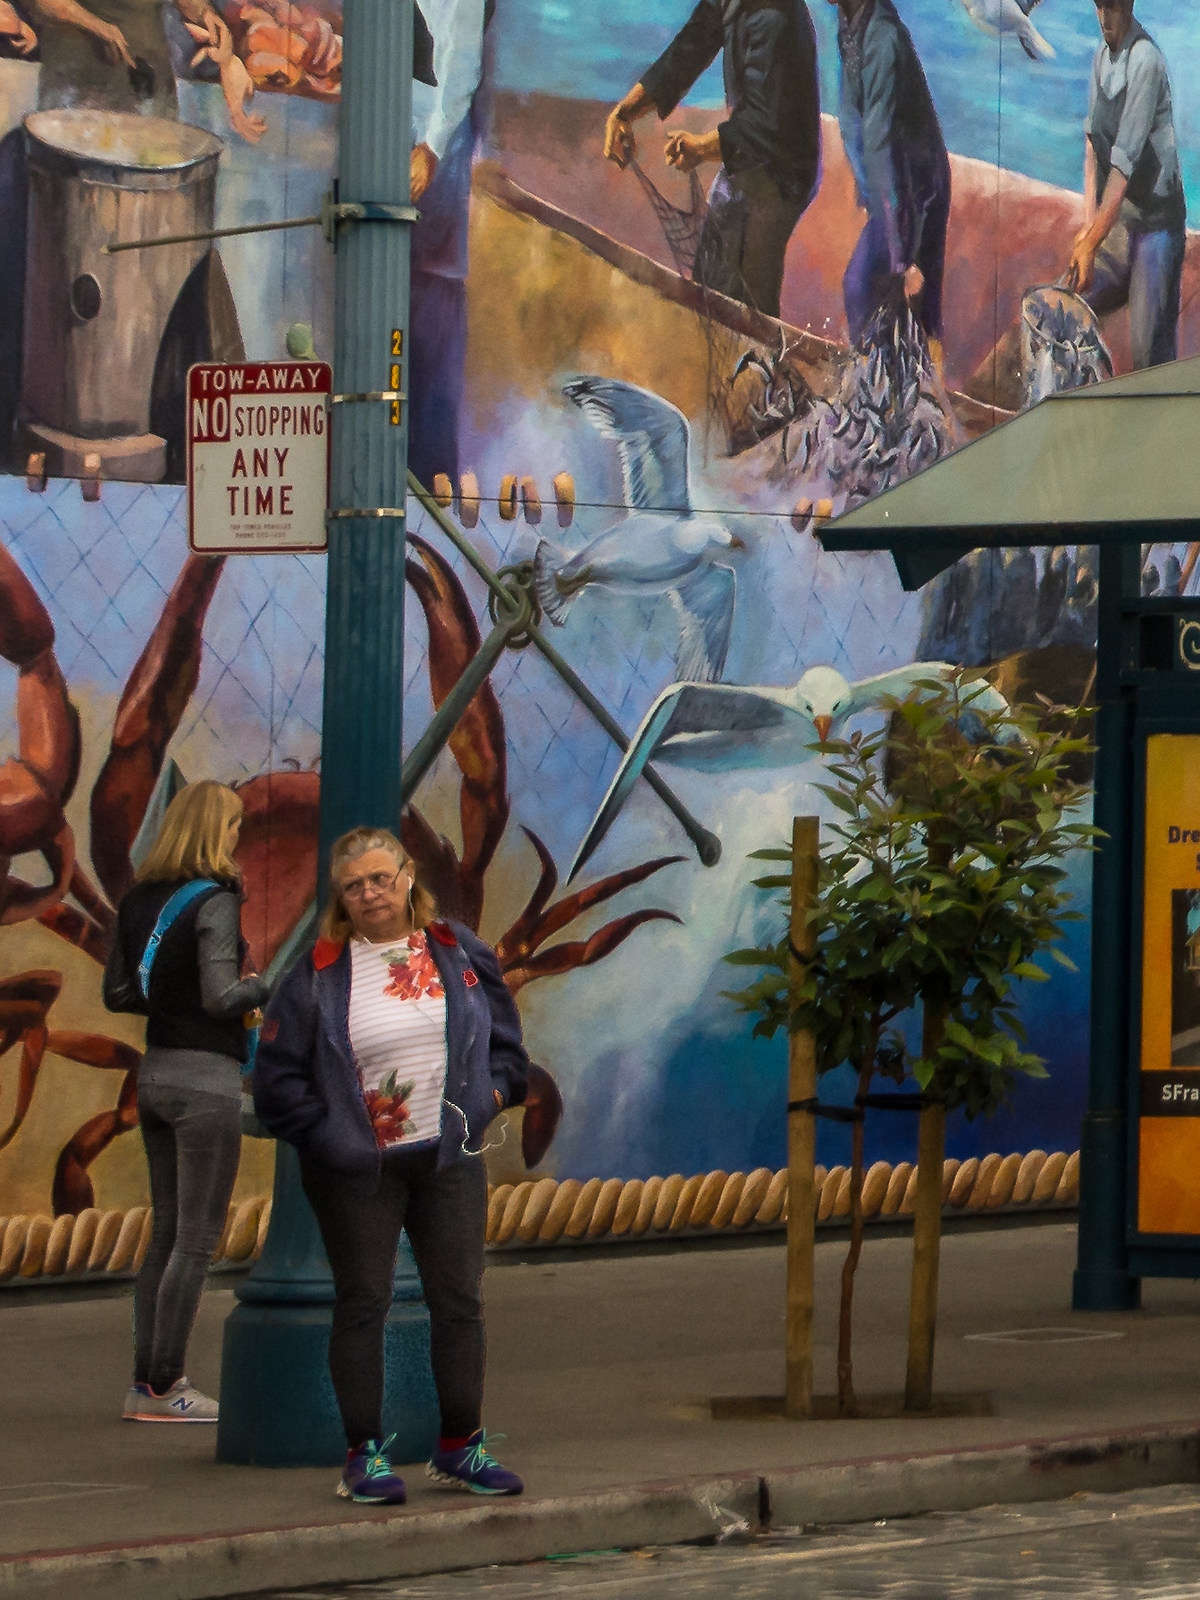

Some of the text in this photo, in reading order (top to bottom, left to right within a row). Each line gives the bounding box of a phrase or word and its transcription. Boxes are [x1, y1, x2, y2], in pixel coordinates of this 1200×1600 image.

[200, 368, 321, 391] TOW-AWAY
[193, 397, 324, 438] NO STOPPING
[232, 447, 290, 478] ANY
[226, 485, 294, 516] TIME
